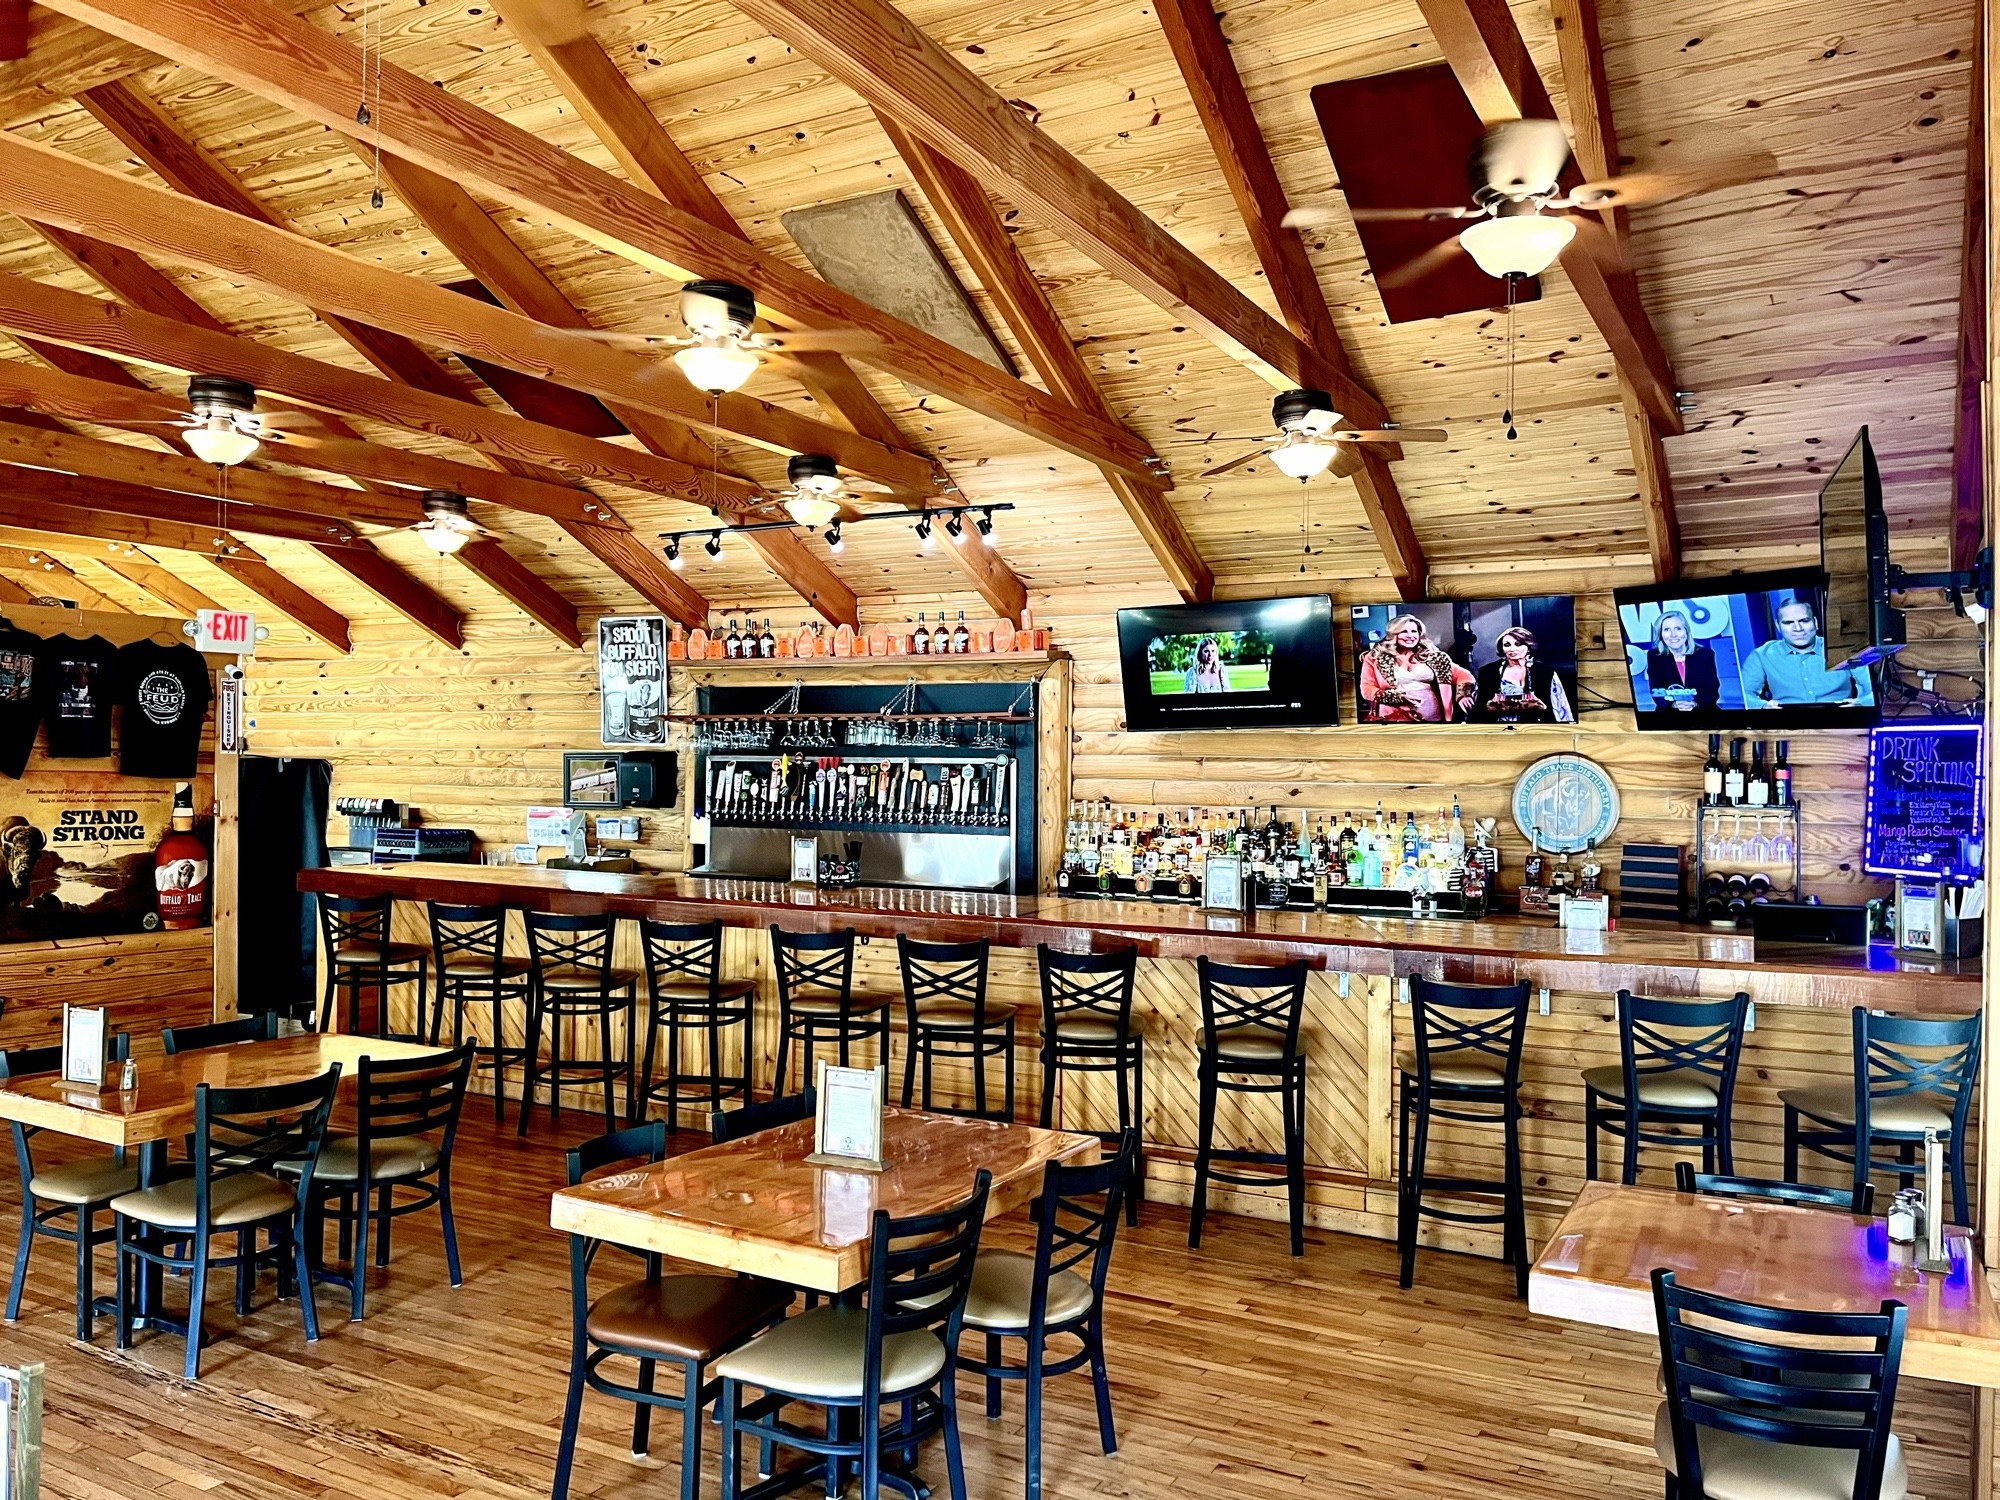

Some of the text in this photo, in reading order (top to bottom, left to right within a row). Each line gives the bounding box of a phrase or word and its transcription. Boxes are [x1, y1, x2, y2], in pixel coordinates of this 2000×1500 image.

[213, 613, 248, 641] EXIT
[613, 627, 650, 644] SHOOT
[608, 644, 656, 660] BUFFALO
[608, 661, 658, 677] ON SIGHT
[147, 695, 179, 703] FEUD
[1883, 737, 1940, 761] DRINK
[1901, 760, 1974, 788] SPECIALS
[1520, 763, 1610, 809] BUFFALO TRACE DISTILLERY
[61, 810, 138, 825] STAND
[53, 826, 145, 841] STRONG
[1879, 824, 1906, 841] Mango
[1907, 824, 1932, 837] Peach
[160, 893, 202, 904] BUFFALO TRACE
